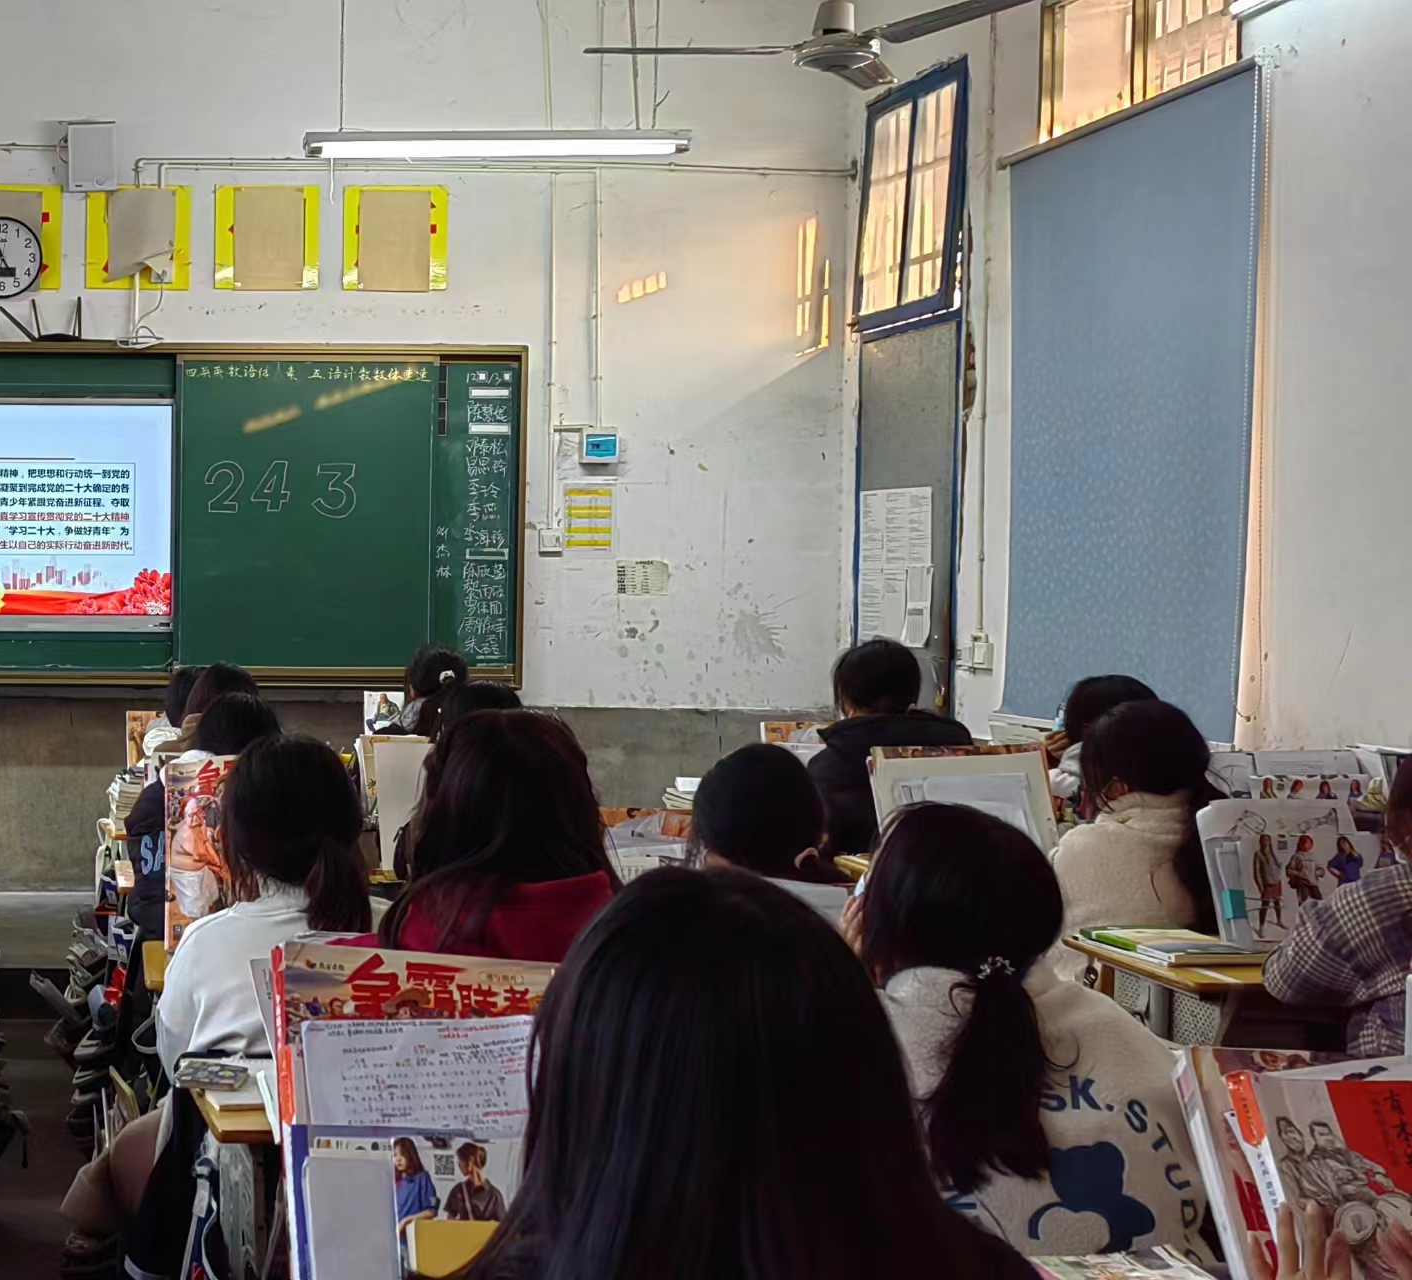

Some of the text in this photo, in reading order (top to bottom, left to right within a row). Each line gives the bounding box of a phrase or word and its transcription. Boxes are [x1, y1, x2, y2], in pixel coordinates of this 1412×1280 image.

[15, 228, 20, 238] 1
[24, 238, 31, 248] 2
[29, 253, 36, 262] 3
[24, 267, 31, 277] 4
[0, 281, 5, 291] 6
[13, 278, 20, 287] 5
